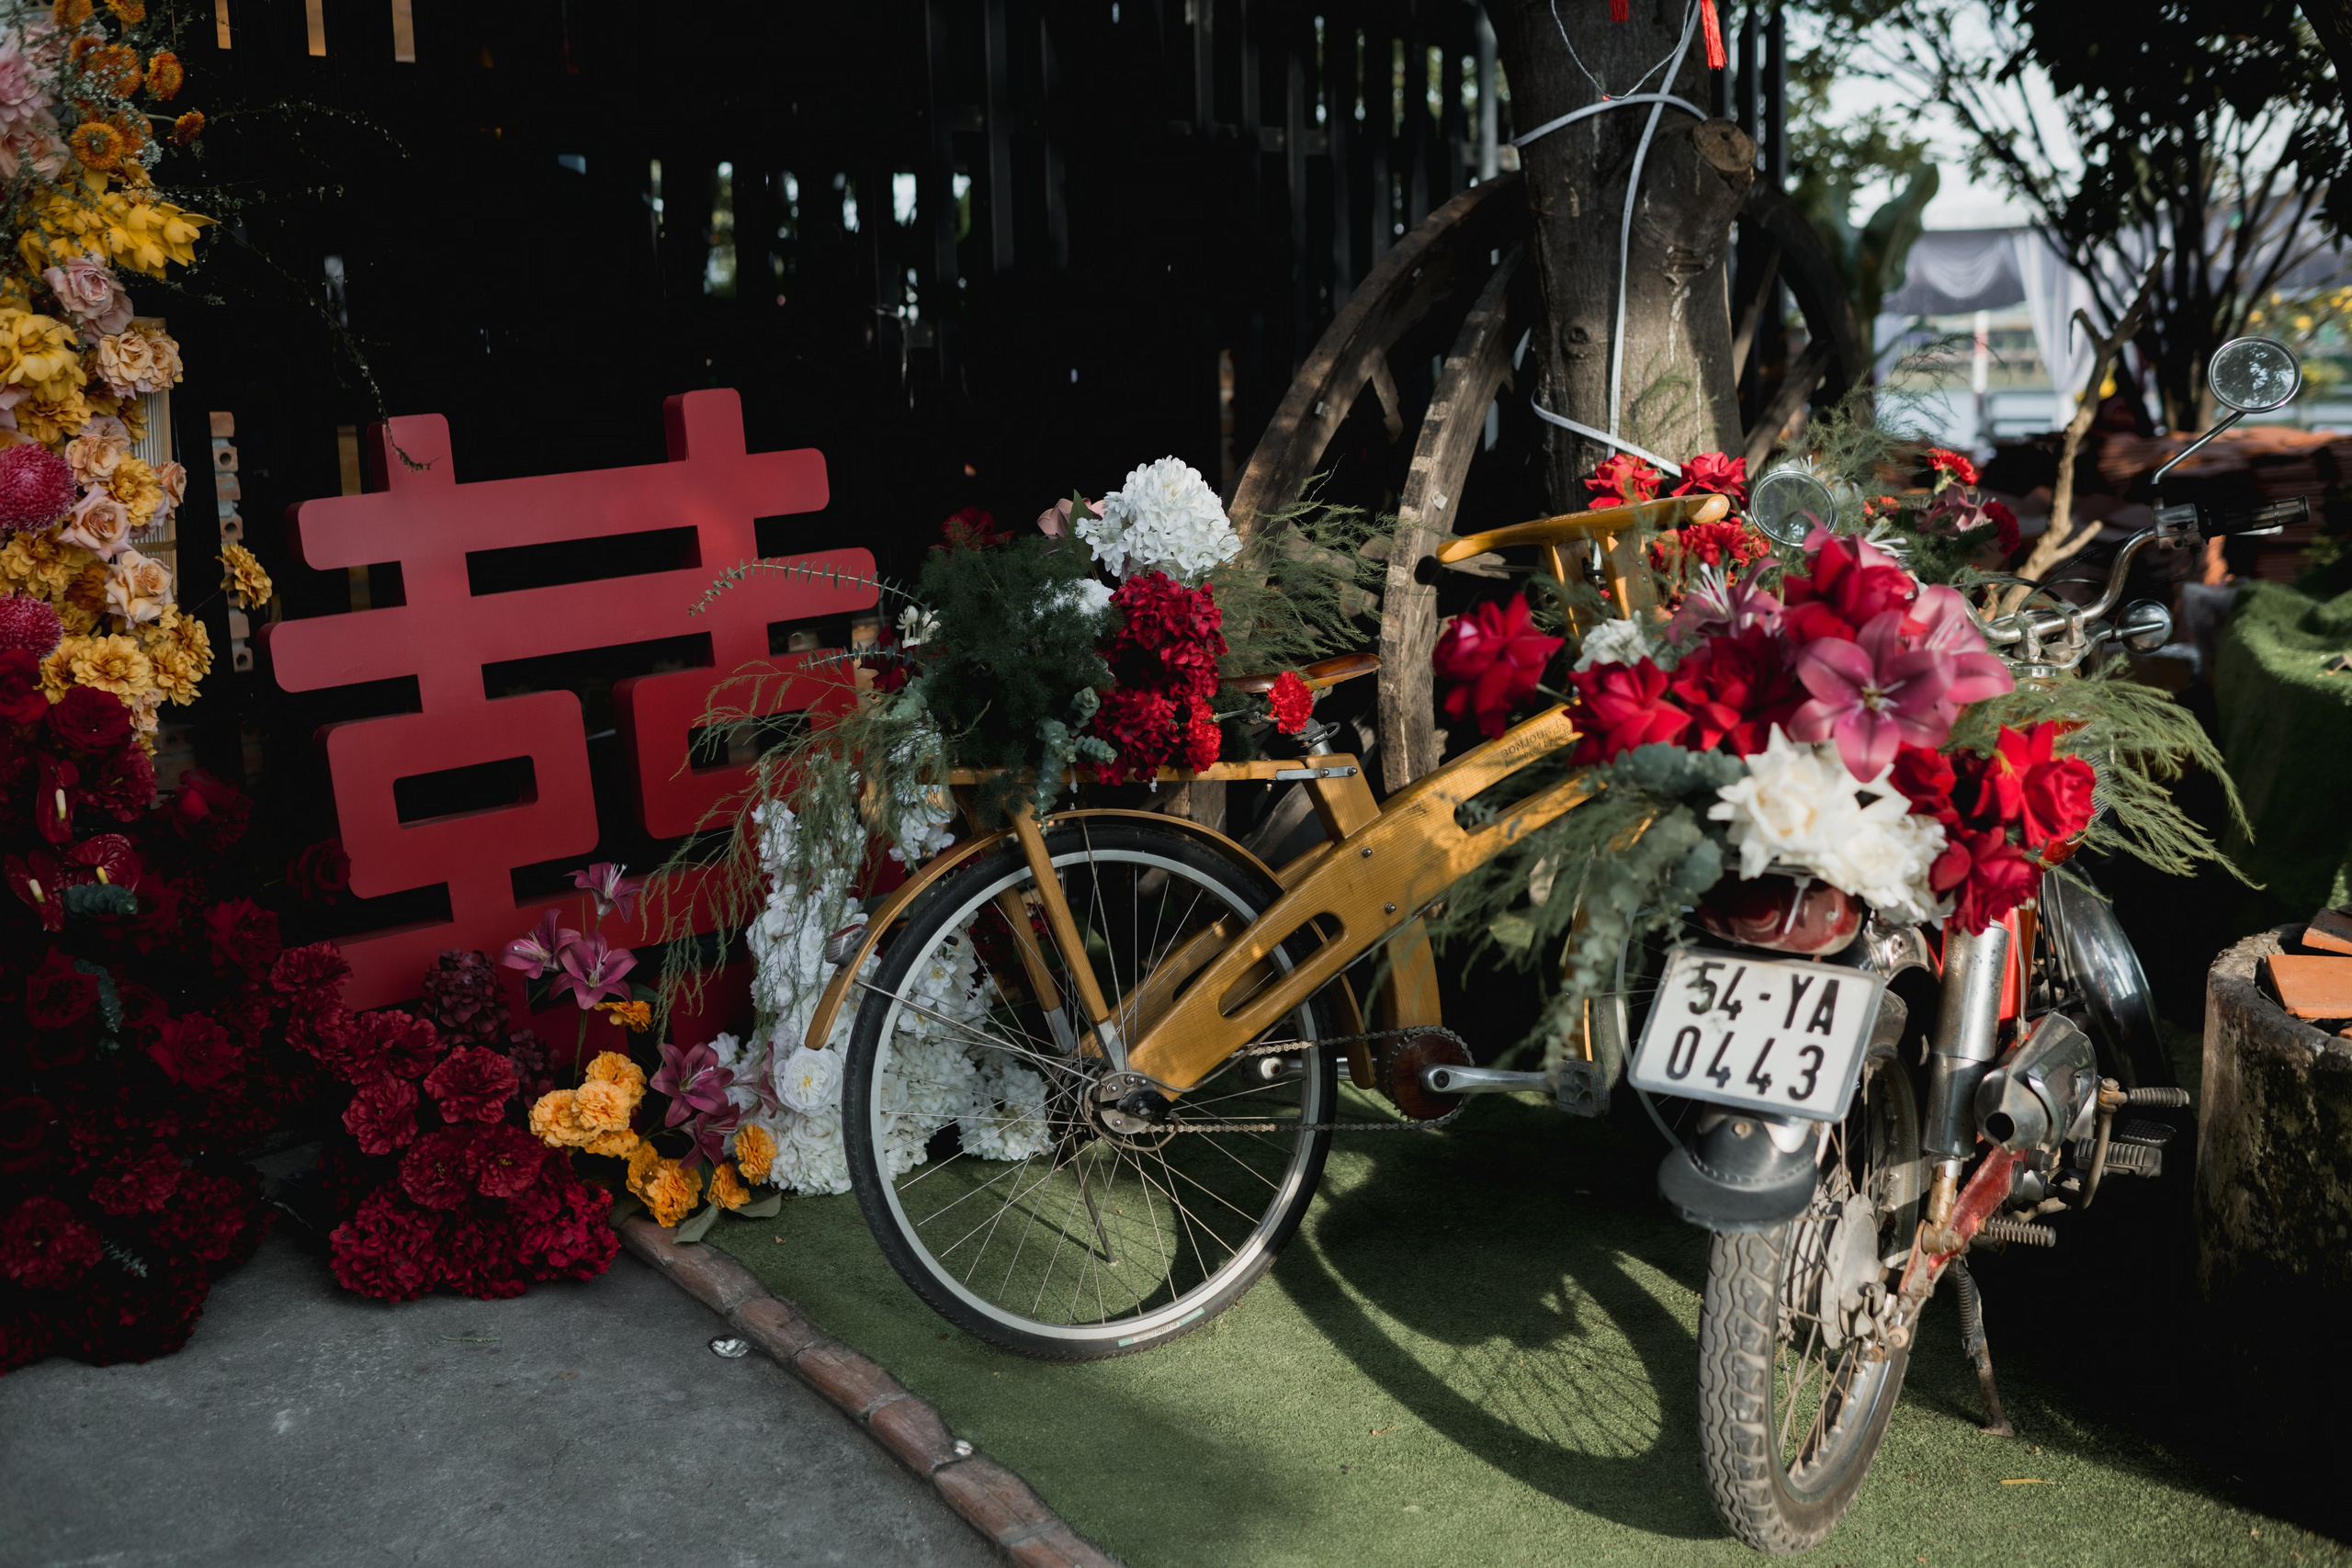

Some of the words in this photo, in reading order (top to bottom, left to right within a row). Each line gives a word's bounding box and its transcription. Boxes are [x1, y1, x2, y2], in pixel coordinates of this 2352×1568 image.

[1516, 742, 1542, 761] moved
[1544, 738, 1553, 748] by
[1555, 730, 1572, 742] natu
[1688, 961, 1840, 1035] 54-YA
[1665, 1025, 1826, 1101] 0443
